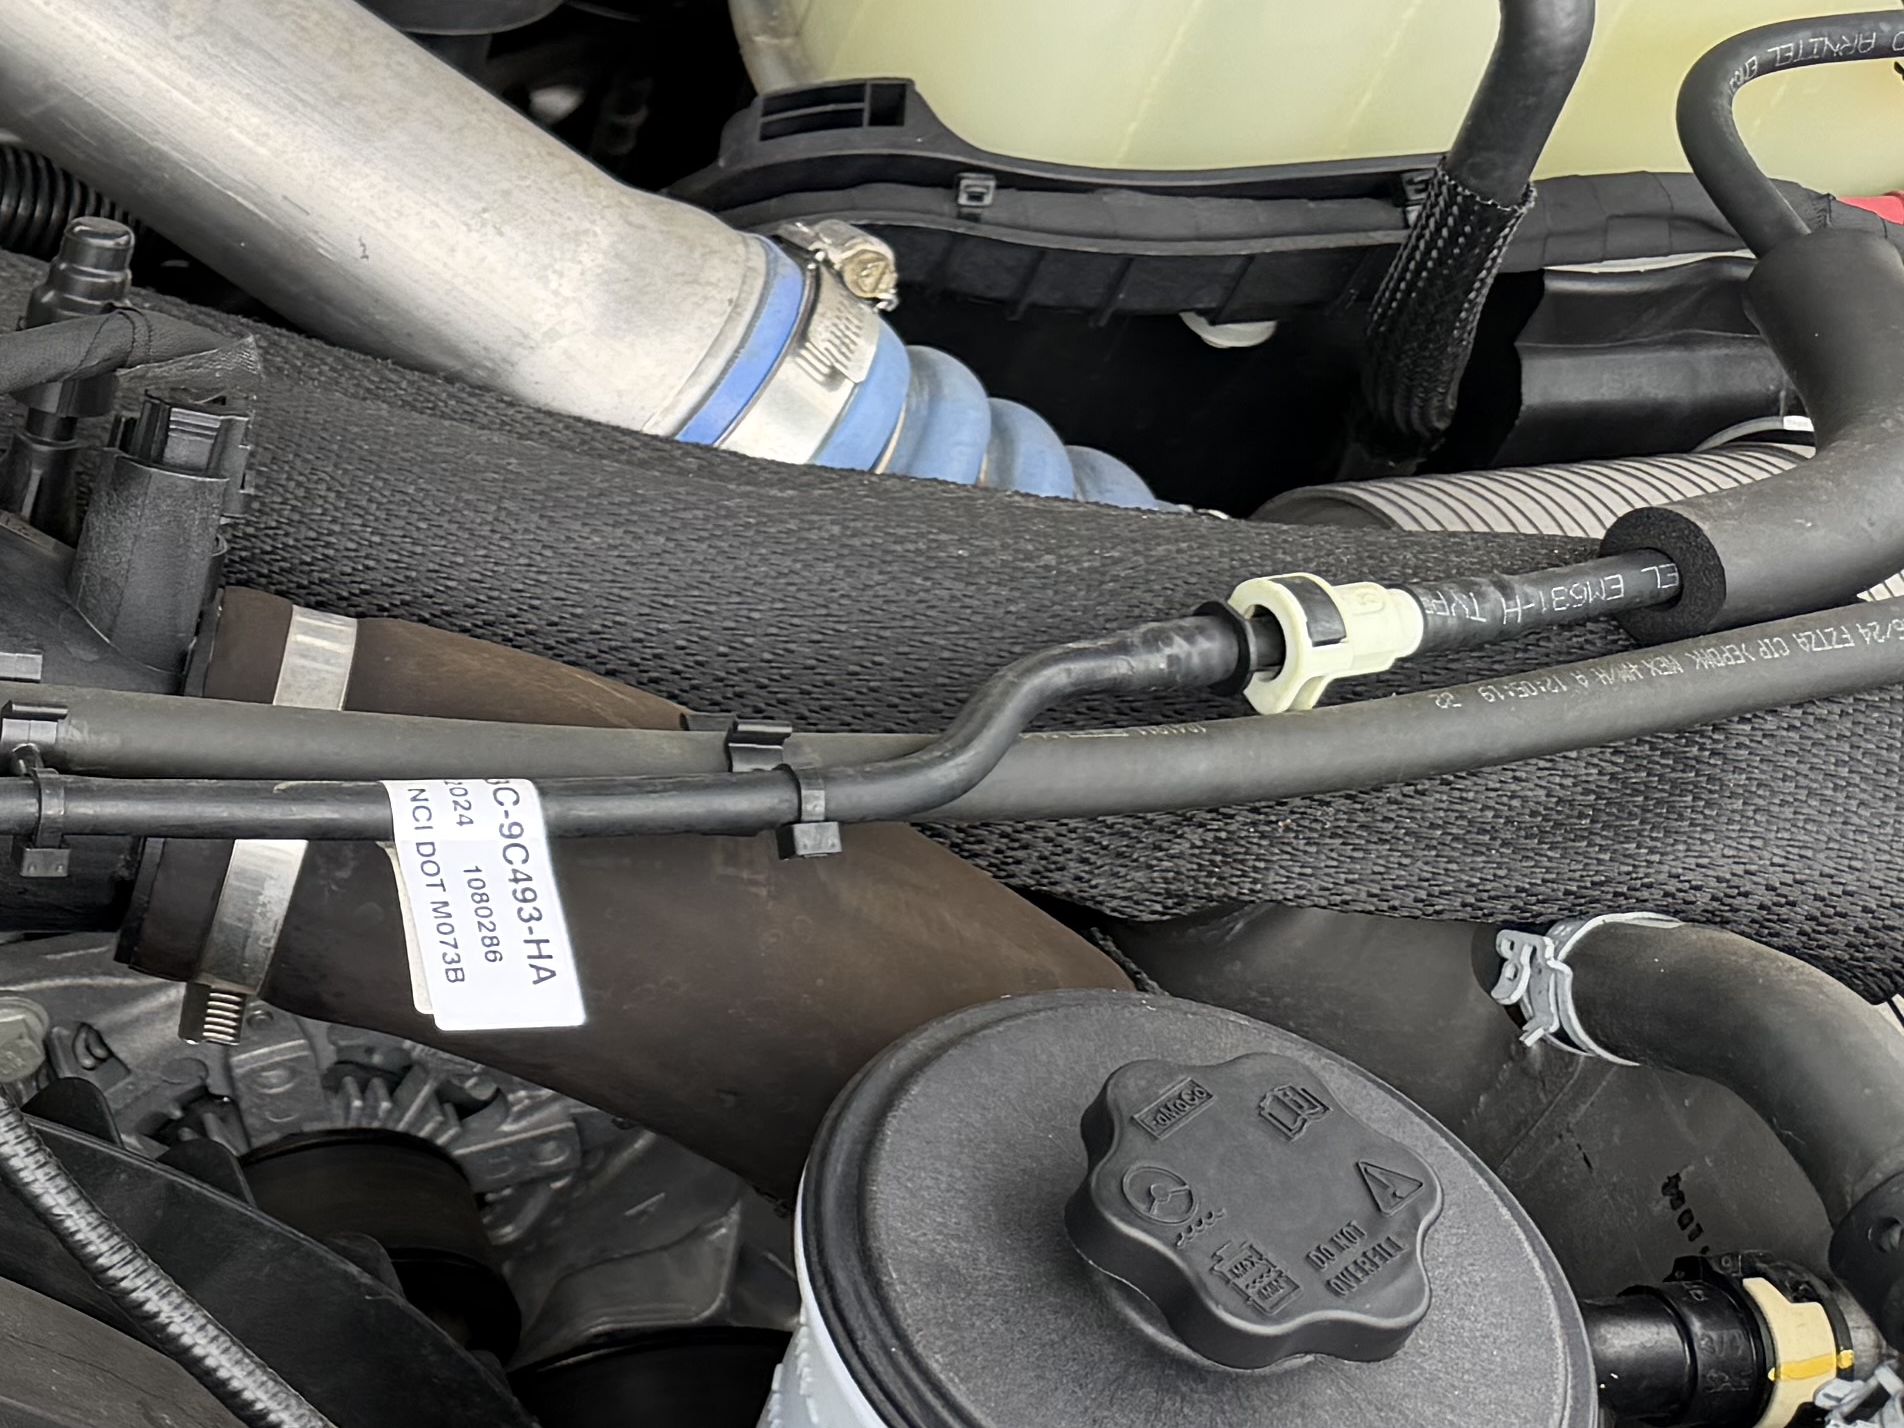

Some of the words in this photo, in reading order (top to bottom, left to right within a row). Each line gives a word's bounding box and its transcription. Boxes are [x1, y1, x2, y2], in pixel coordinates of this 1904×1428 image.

[408, 788, 434, 831] NCI
[415, 841, 447, 892] DOT
[463, 865, 503, 963] 1080286
[430, 901, 465, 984] M073B
[1306, 1243, 1335, 1270] DO
[1332, 1221, 1366, 1251] NOT
[1326, 1236, 1406, 1296] OVERFILL
